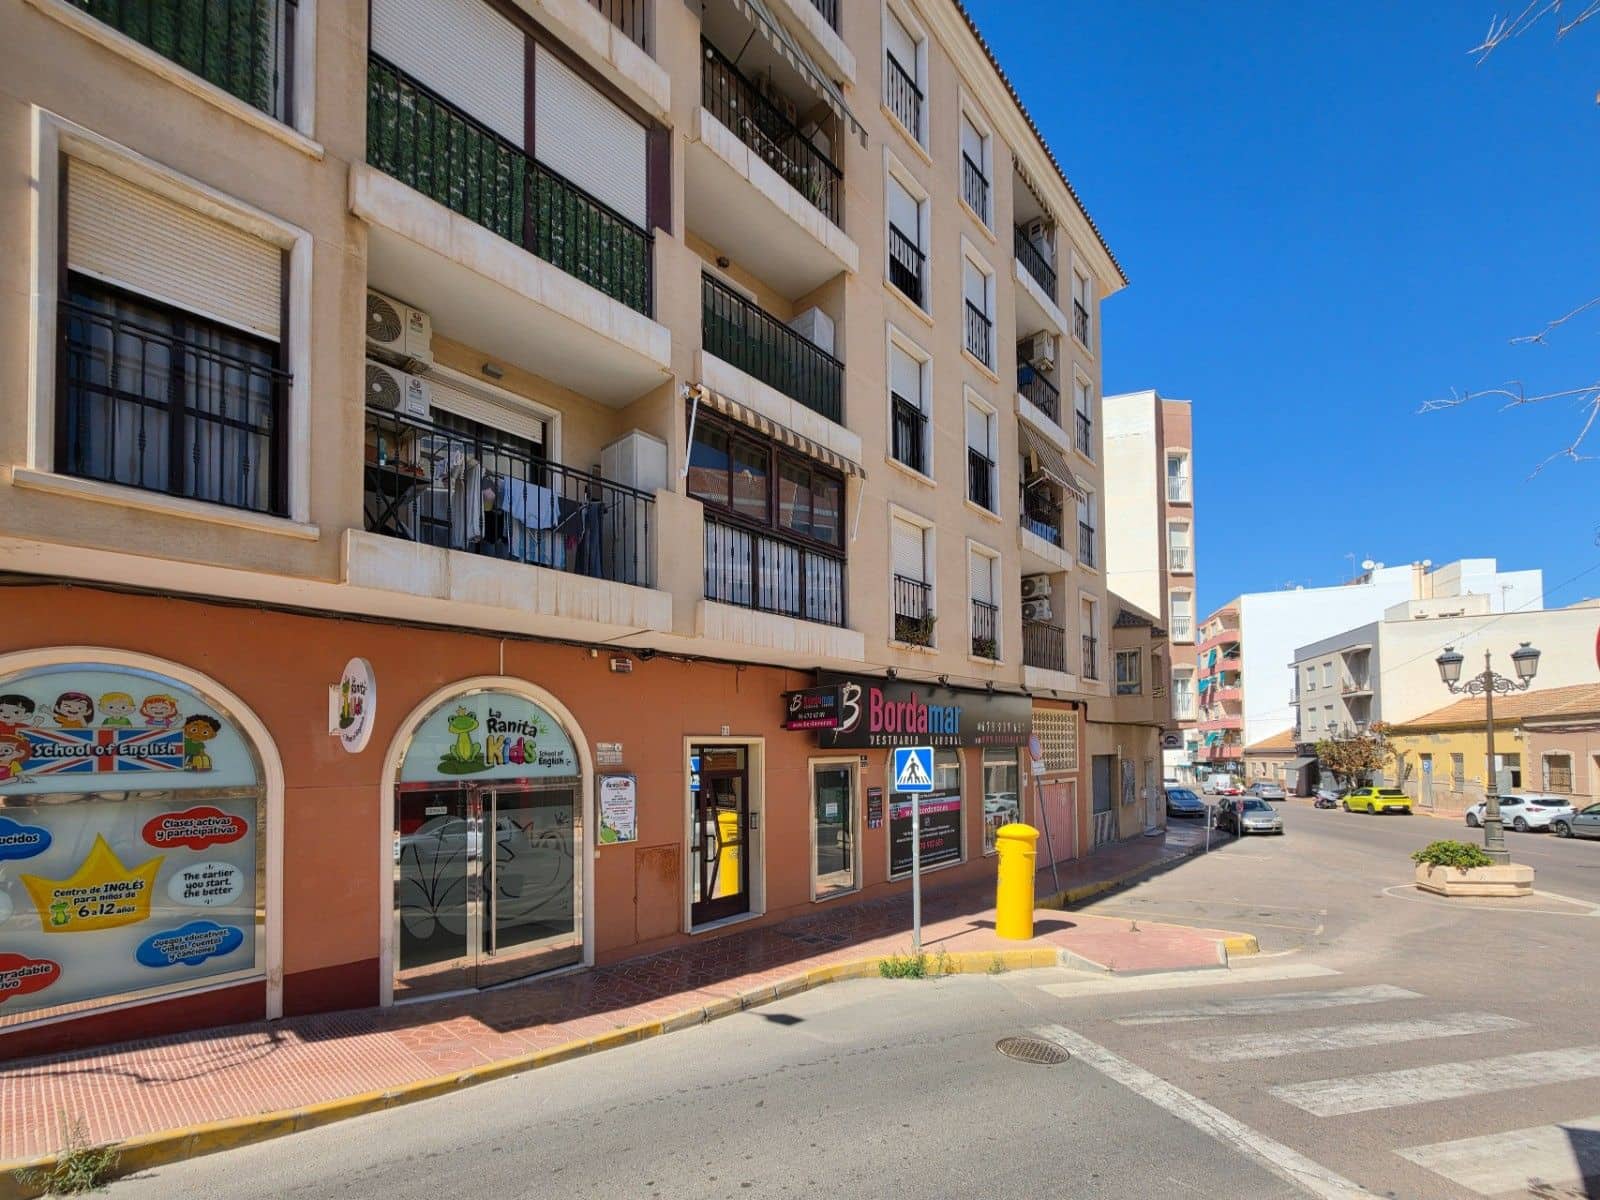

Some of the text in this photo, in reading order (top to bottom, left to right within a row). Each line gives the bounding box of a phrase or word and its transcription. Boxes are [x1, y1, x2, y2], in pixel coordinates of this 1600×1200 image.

[489, 708, 502, 719] La
[869, 687, 962, 733] Bordamar
[486, 717, 538, 738] Ranita
[869, 735, 919, 745] VESTUARIO
[33, 743, 178, 758] School of English
[486, 735, 537, 766] Kids
[538, 757, 565, 768] English
[163, 818, 232, 829] Clases activas
[156, 826, 237, 841] y participativas
[184, 870, 234, 881] The earlier
[54, 880, 145, 898] Centro de INGLÉS
[185, 881, 204, 891] you
[184, 887, 233, 899] the better
[73, 896, 98, 906] para
[78, 905, 90, 918] 6
[99, 903, 115, 915] 12
